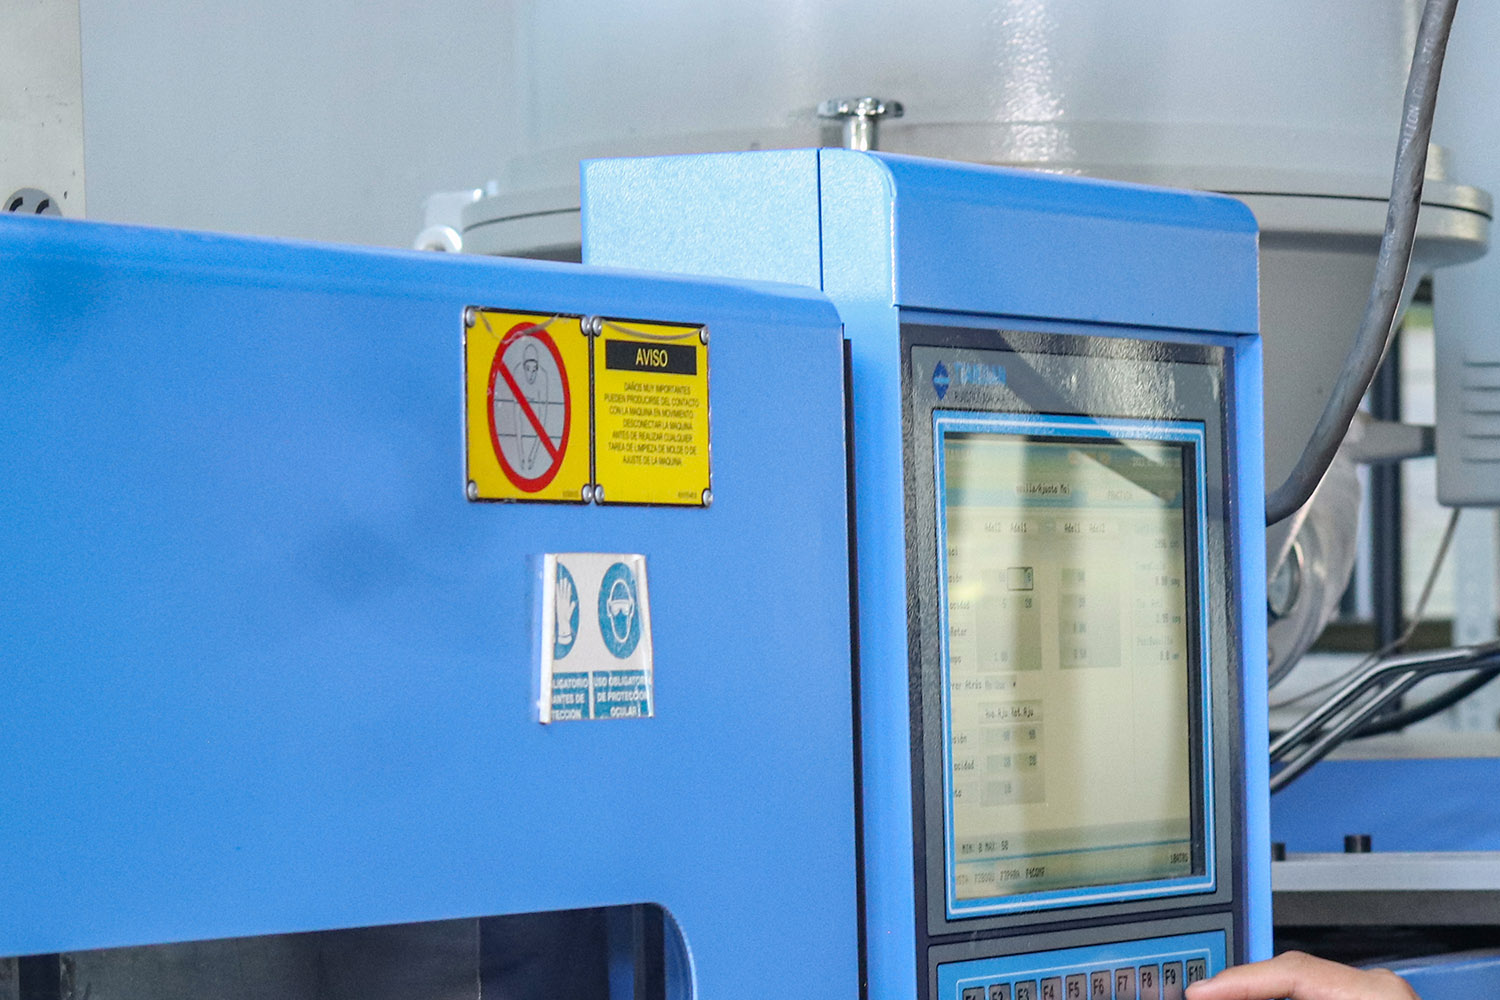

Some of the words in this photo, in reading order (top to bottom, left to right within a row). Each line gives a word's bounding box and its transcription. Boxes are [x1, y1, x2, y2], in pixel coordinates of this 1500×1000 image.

[636, 348, 668, 367] AVISO
[597, 691, 607, 702] DE
[1068, 981, 1080, 999] F5
[1093, 978, 1104, 995] F6
[1117, 975, 1128, 992] F7
[1141, 971, 1153, 988] F8
[1165, 968, 1176, 986] F9
[1188, 965, 1204, 981] F10
